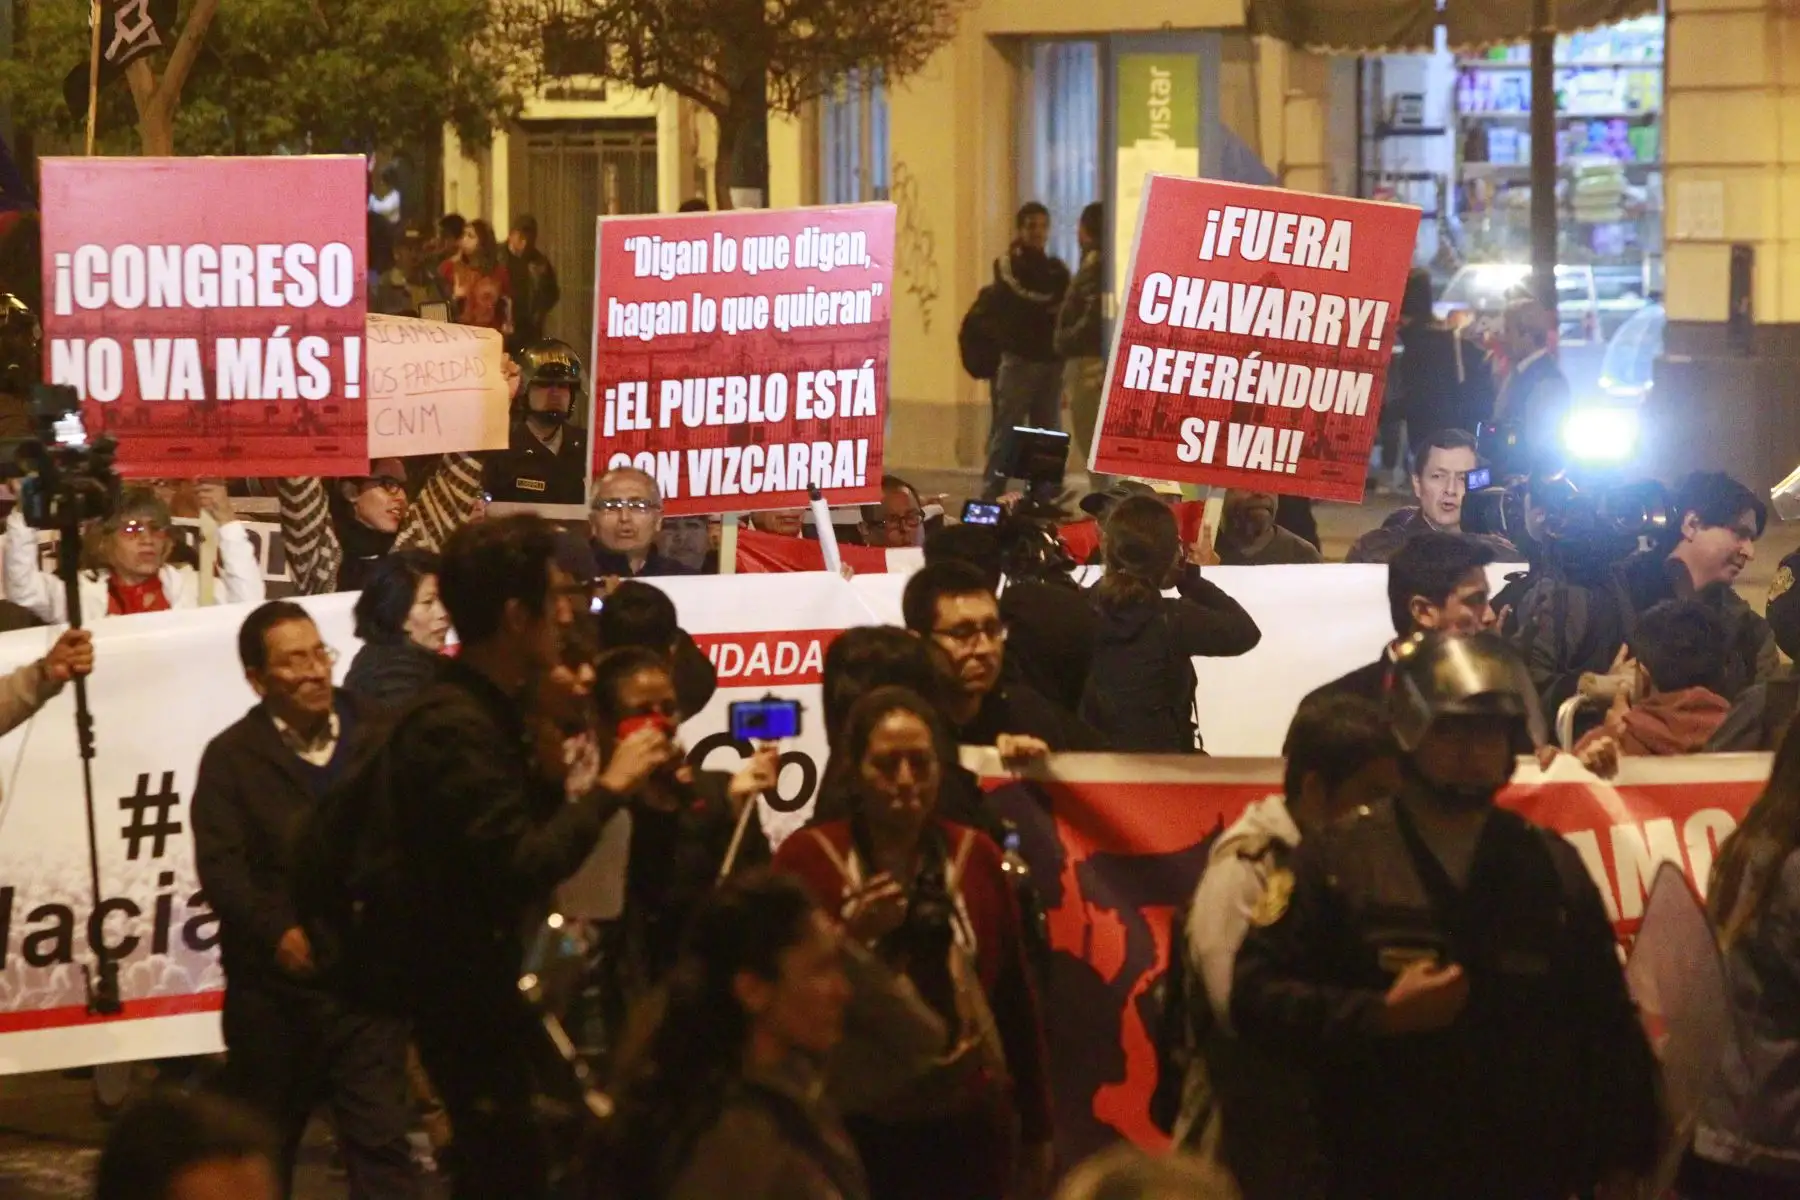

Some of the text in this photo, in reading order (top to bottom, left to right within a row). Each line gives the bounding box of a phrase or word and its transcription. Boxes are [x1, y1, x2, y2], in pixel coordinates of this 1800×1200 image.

[712, 232, 737, 273] lo
[742, 234, 790, 275] que
[795, 227, 871, 272] digan,
[1199, 205, 1352, 272] ¡FUERA
[54, 243, 354, 315] ¡CONGRESO
[366, 324, 493, 345] ICAMENTE
[607, 297, 687, 341] hagan
[692, 292, 716, 333] lo
[721, 295, 769, 335] que
[1138, 272, 1390, 351] CHAVARRY!
[52, 337, 123, 402] NO
[133, 338, 205, 400] VA
[216, 325, 332, 400] MÁS
[367, 355, 487, 395] OS PARIDAD
[1123, 344, 1373, 416] REFERÉNDUM
[374, 403, 443, 437] CNM
[603, 359, 876, 437] ¡EL PUEBLO ESTÁ
[686, 438, 868, 497] VIZCARRA!
[1176, 416, 1304, 474] SI VA!!
[0, 871, 220, 969] acia
